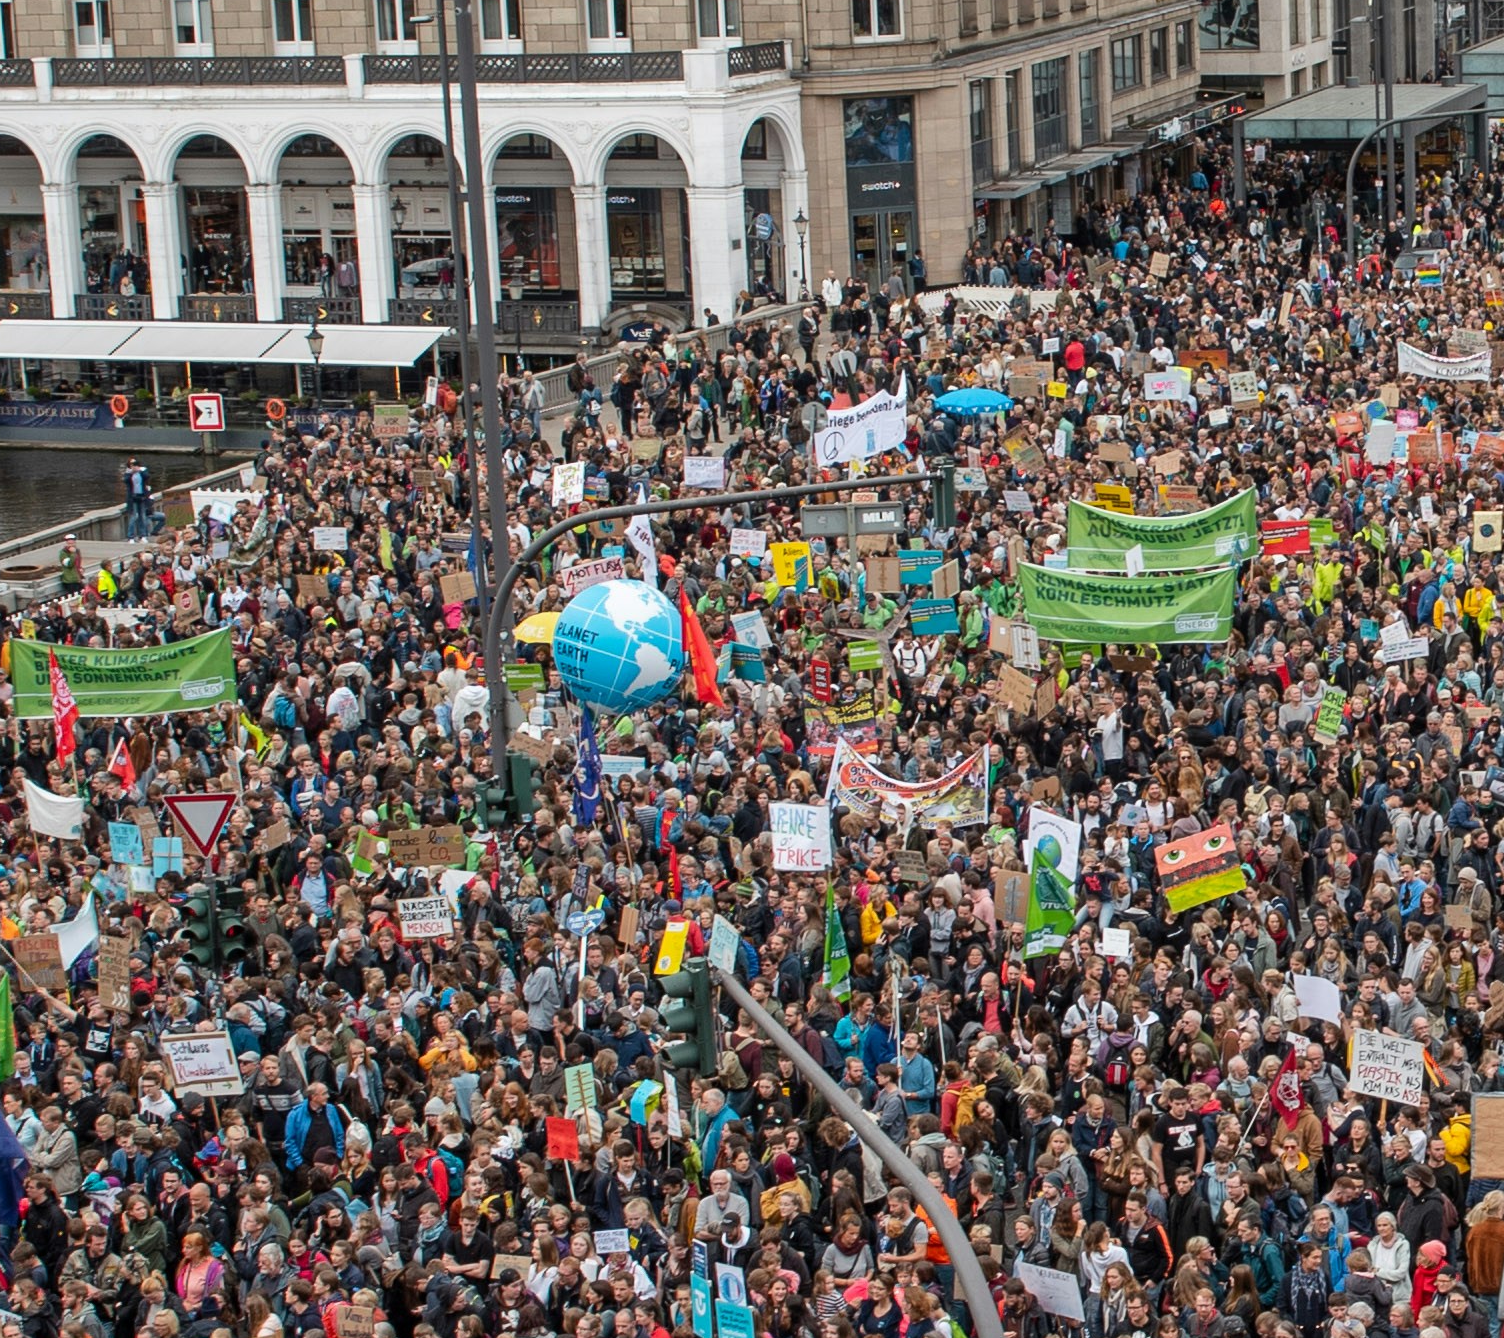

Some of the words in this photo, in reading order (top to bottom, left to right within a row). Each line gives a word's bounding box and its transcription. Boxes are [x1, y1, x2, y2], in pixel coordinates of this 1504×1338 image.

[60, 407, 96, 419] ALSTER
[863, 513, 895, 523] MLM
[1036, 585, 1181, 608] KOHLESCHMUTZ.
[557, 624, 600, 646] PLANET
[557, 641, 589, 663] EARTH
[561, 664, 585, 681] FIRST
[391, 836, 419, 847] make
[406, 921, 444, 934] MENSCH
[171, 1041, 211, 1056] Schluss
[1359, 1032, 1378, 1047] DIE
[1381, 1037, 1411, 1055] WELT
[1362, 1079, 1382, 1093] KIM
[1401, 1087, 1420, 1102] ASS
